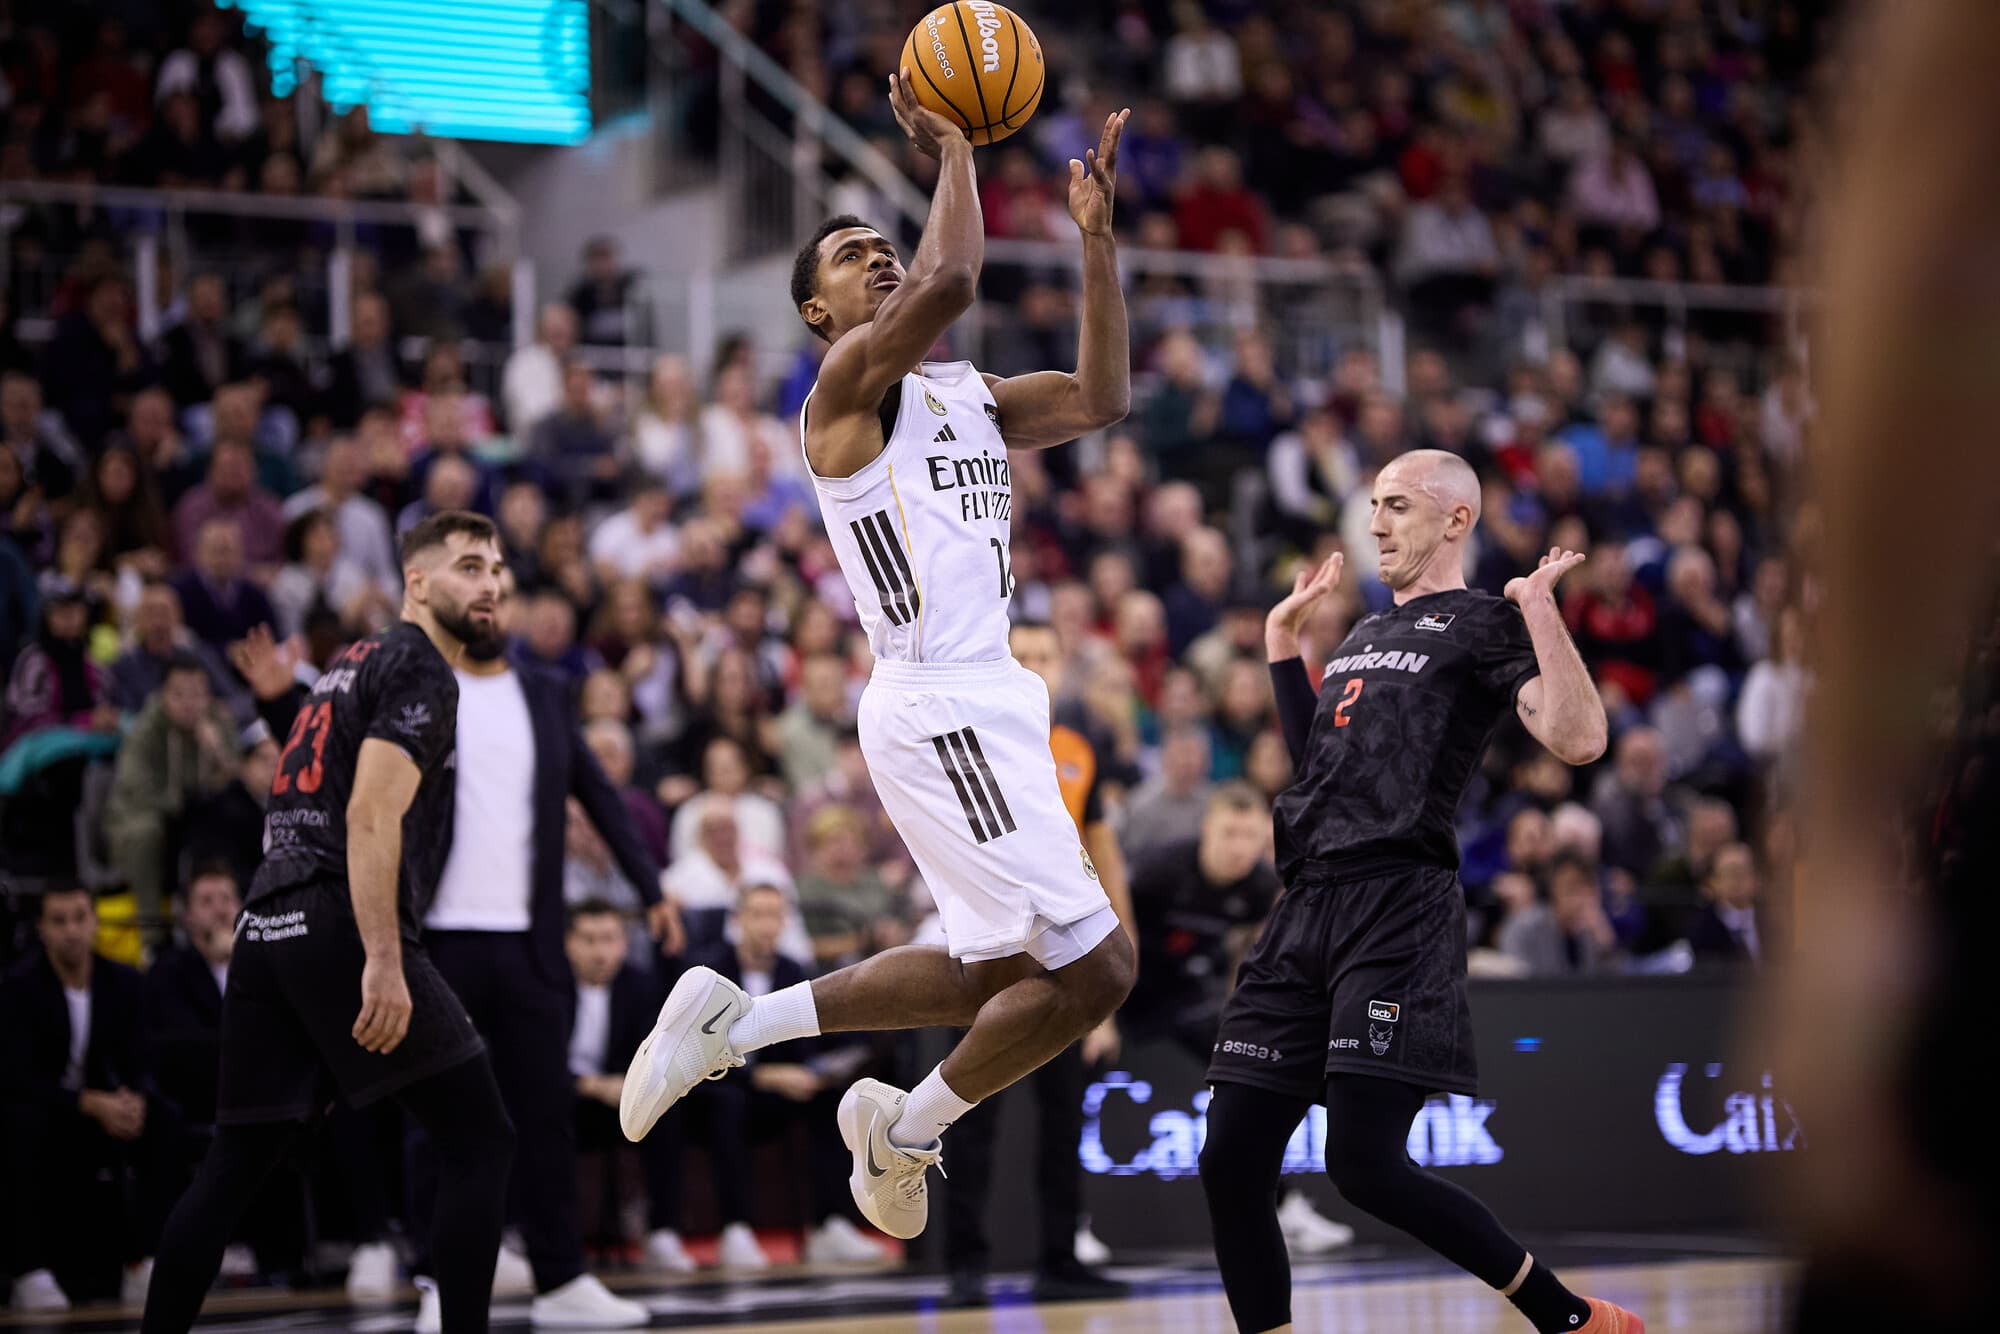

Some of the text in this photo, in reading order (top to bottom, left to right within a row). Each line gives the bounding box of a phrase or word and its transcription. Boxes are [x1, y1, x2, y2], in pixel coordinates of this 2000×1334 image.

[1321, 644, 1430, 682] OVIRAN
[1334, 678, 1364, 728] 2
[272, 700, 333, 795] 23
[1371, 1008, 1391, 1019] acb
[1222, 1040, 1269, 1060] asisa
